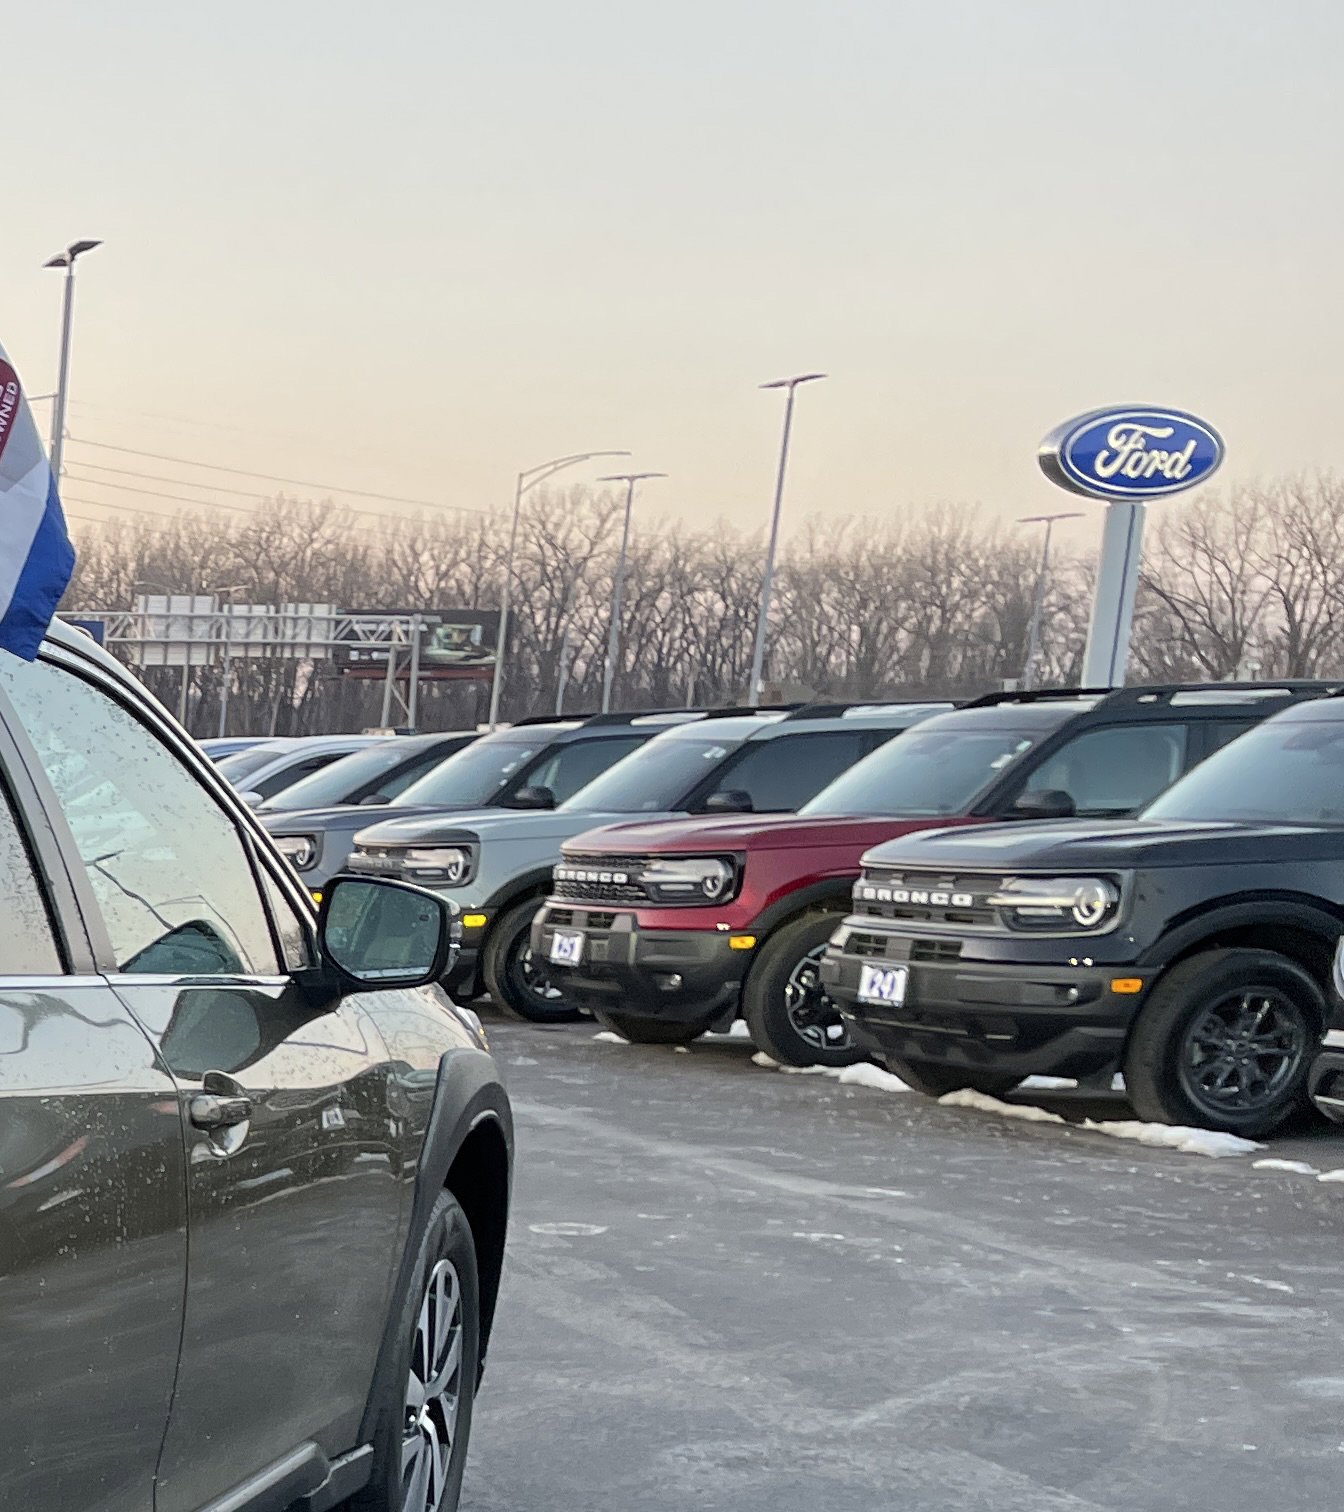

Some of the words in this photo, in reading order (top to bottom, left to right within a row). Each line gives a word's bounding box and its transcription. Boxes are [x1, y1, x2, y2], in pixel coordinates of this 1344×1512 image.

[1094, 423, 1198, 480] Ford
[558, 868, 628, 884] BRONCO
[862, 887, 974, 907] BRONCO
